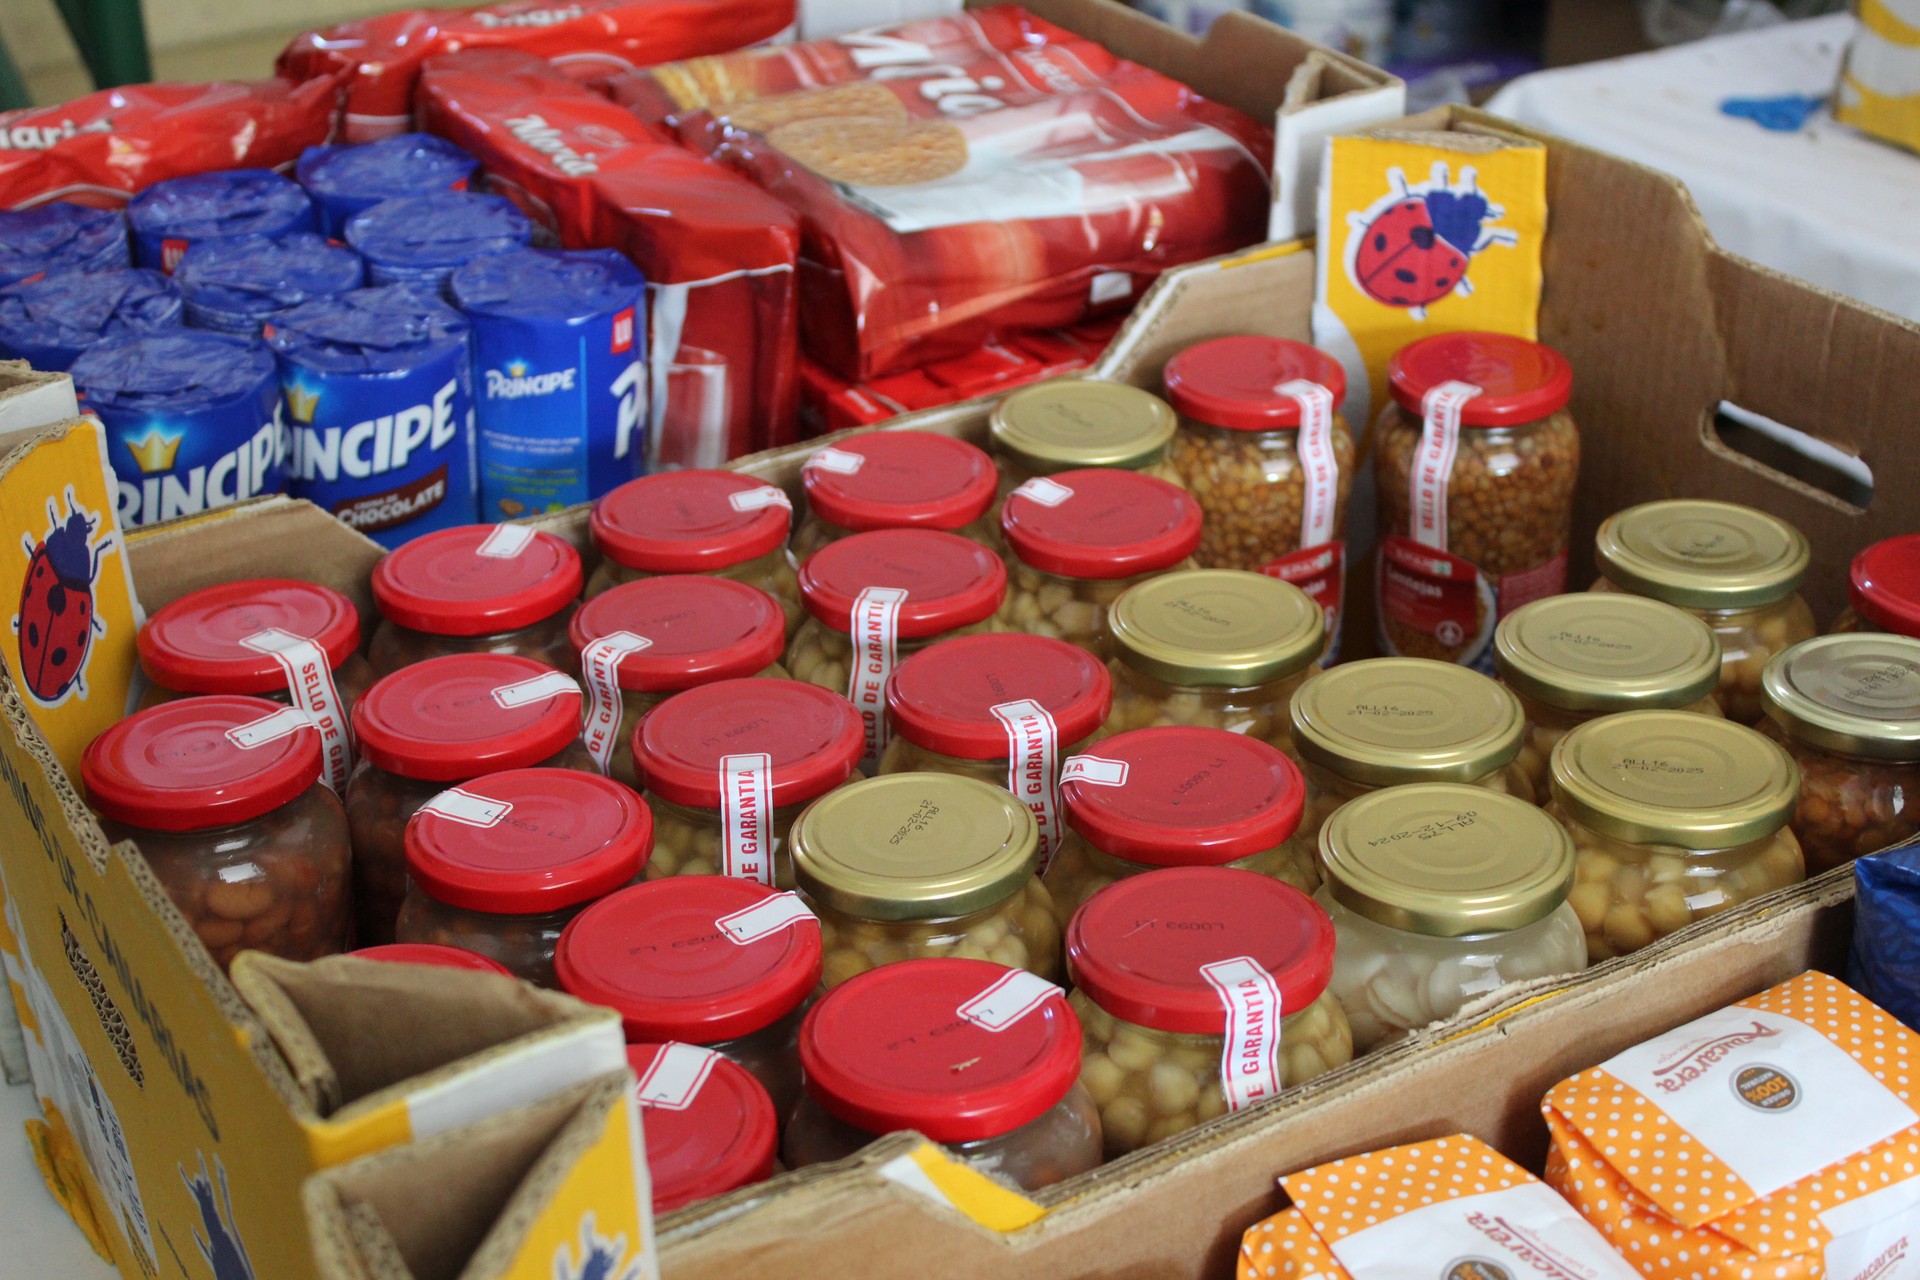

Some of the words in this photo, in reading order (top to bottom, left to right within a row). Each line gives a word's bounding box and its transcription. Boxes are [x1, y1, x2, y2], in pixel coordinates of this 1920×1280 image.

[338, 480, 445, 526] CHOCOLATE
[867, 600, 884, 675] GARANTIA
[302, 662, 326, 713] SELLO
[318, 716, 339, 741] DE
[593, 645, 616, 724] GARANTIA
[863, 679, 880, 704] DE
[588, 729, 605, 754] DE
[864, 711, 877, 760] SELLO
[1020, 714, 1043, 795] GARANTIA
[738, 769, 758, 855] GARANTIA
[1238, 979, 1264, 1075] GARANTIA
[1744, 1075, 1788, 1103] 100%
